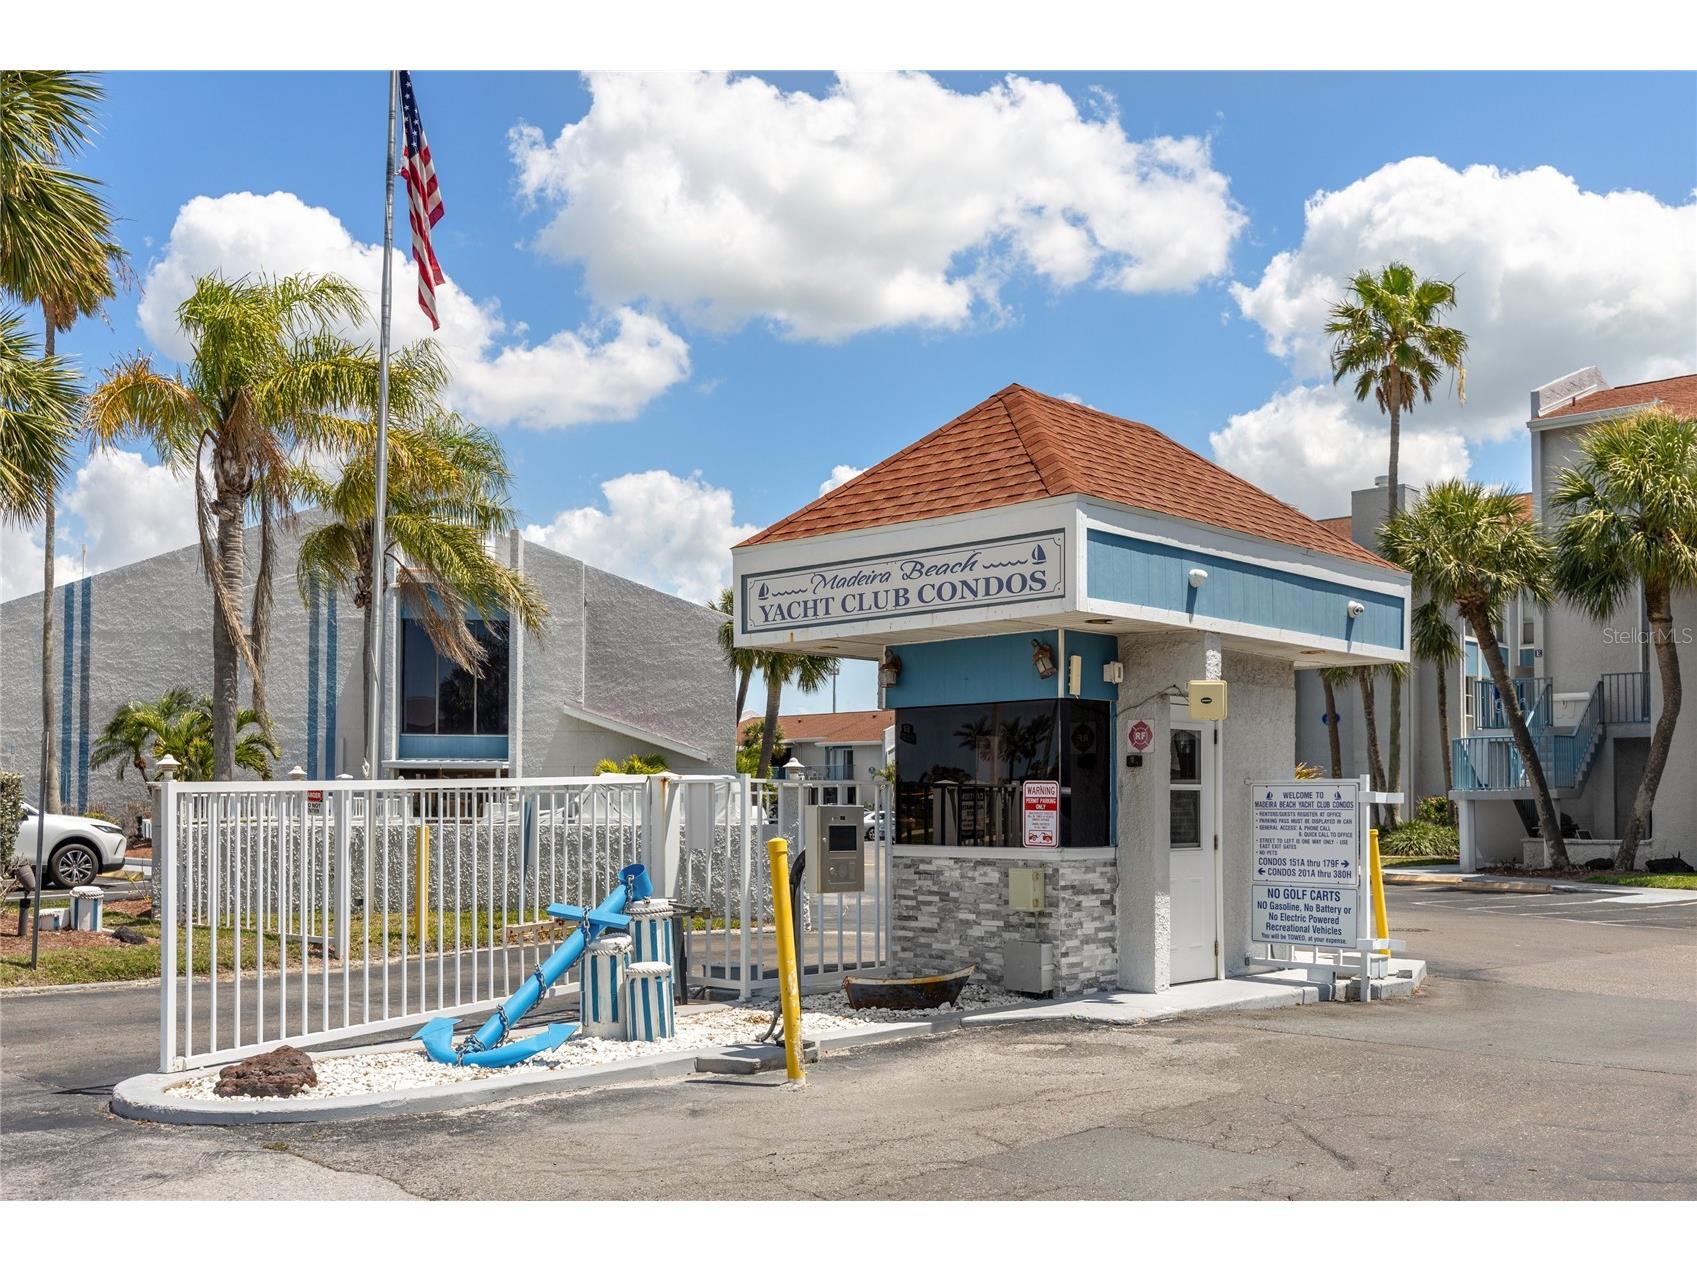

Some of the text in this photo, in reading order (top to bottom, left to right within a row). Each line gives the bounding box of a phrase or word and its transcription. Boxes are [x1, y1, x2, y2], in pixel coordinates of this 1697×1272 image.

[810, 550, 982, 596] Madeira Beach
[759, 570, 1047, 623] YACHT CLUB CONDOS
[1026, 786, 1056, 796] WARNING
[1258, 857, 1339, 868] CONDOS 151A thru 179F
[1268, 868, 1352, 878] CONDOS 201A thru 380H
[1268, 888, 1340, 902] NO GOLF CARTS
[1257, 901, 1267, 909] NO
[1316, 904, 1341, 915] Battery
[1280, 913, 1306, 923] Electric
[1309, 915, 1339, 924] Powered
[1266, 923, 1342, 935] Recreational Vehicles
